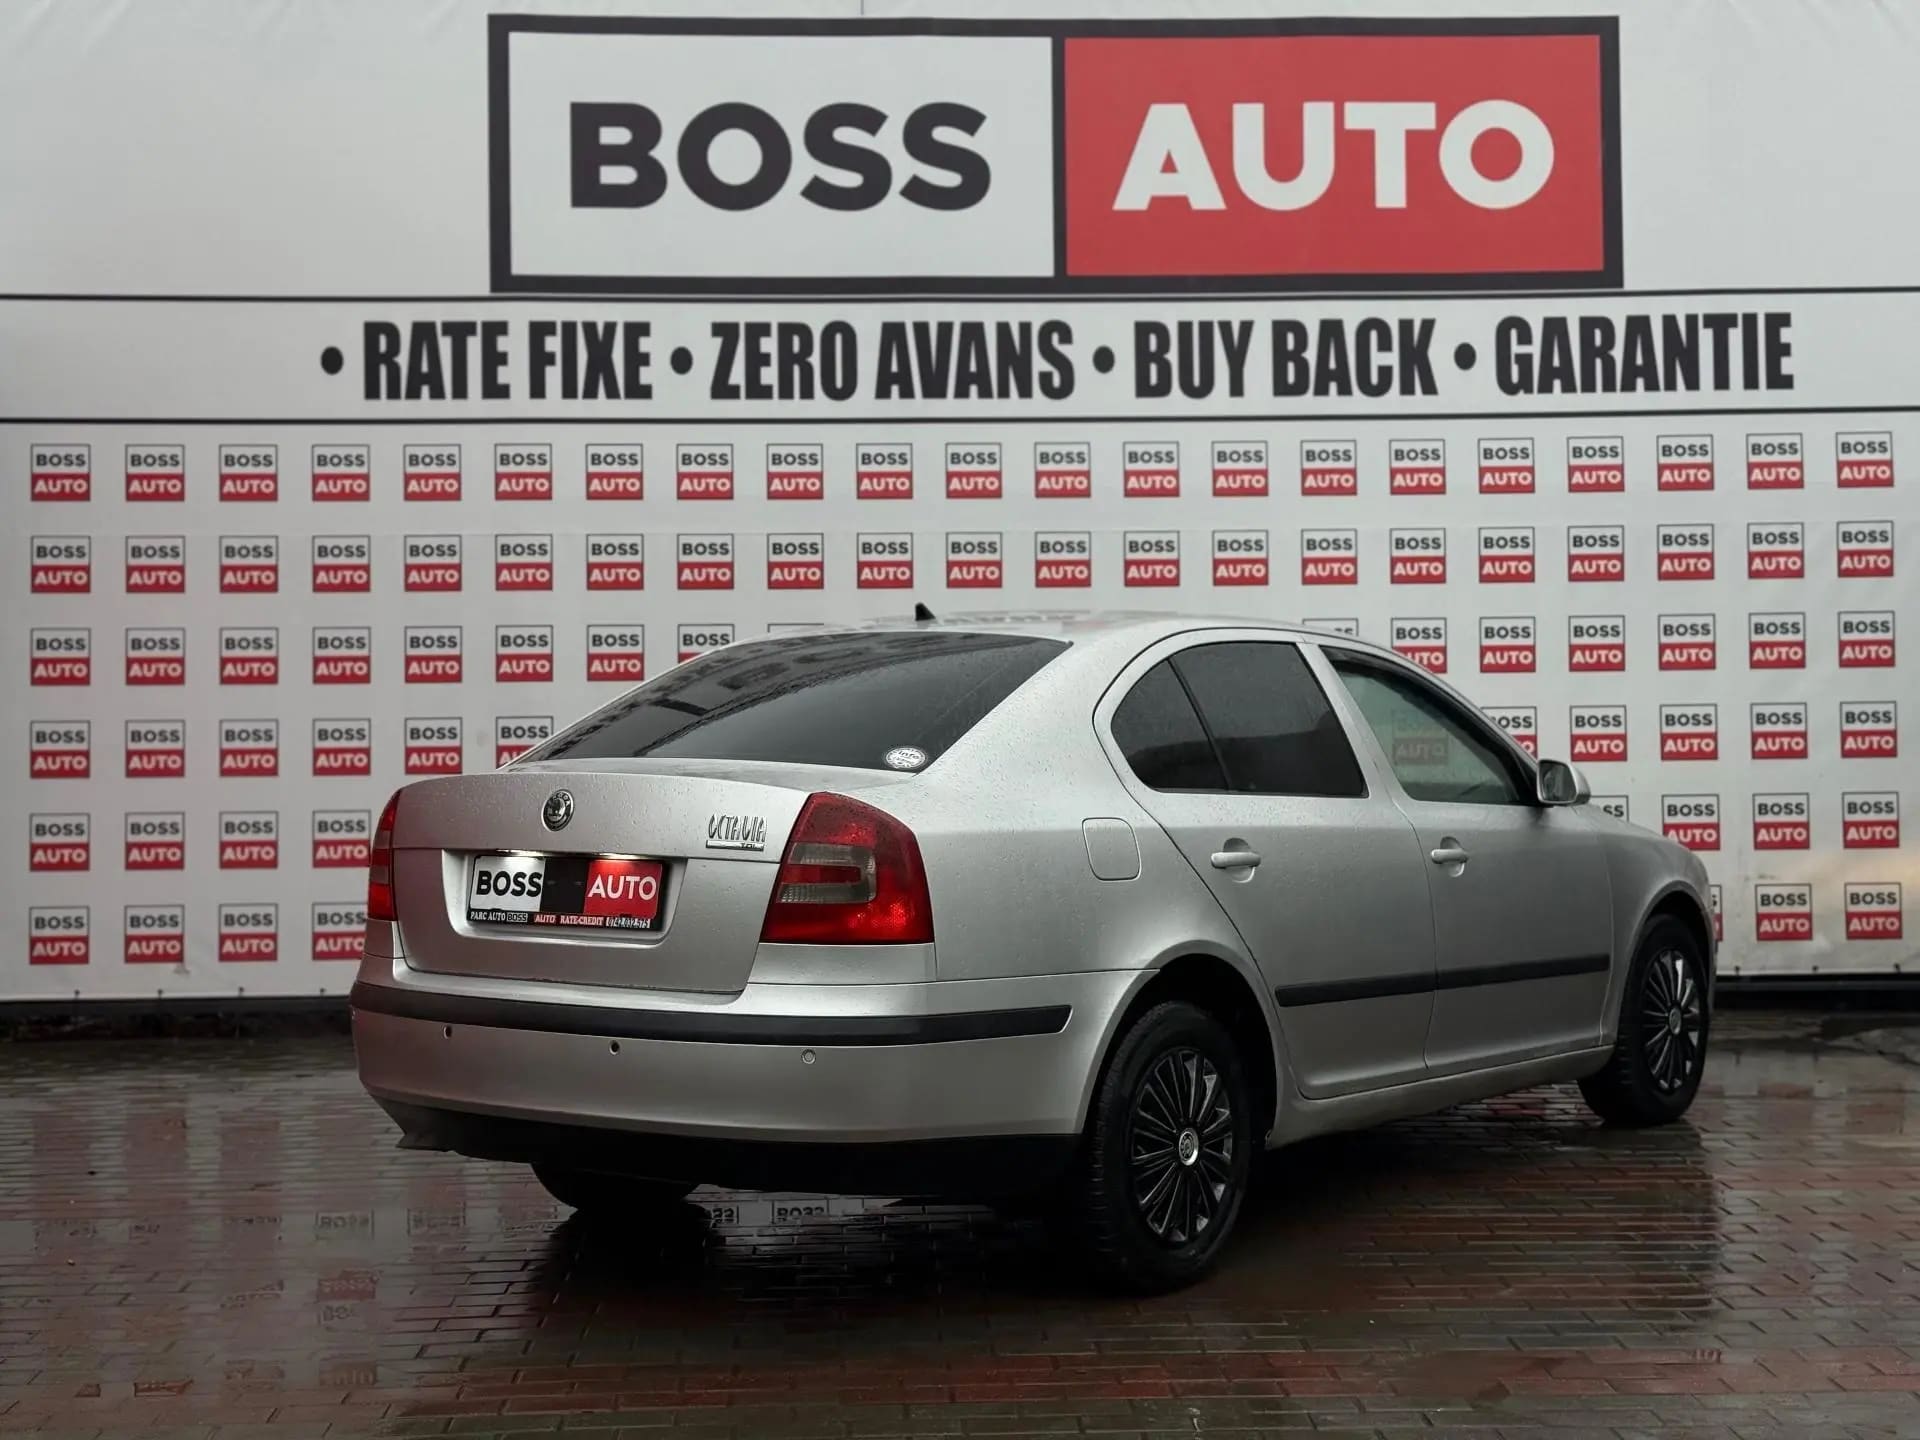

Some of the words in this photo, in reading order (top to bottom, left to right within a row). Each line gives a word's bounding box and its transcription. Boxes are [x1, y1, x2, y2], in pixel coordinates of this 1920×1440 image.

[569, 101, 992, 212] BOSS
[1111, 98, 1555, 212] AUTO
[362, 320, 509, 401] RATE
[527, 320, 653, 400] FIXE
[708, 319, 859, 402] ZERO
[874, 318, 1076, 402] AVANS
[1133, 319, 1255, 400] BUY
[1270, 317, 1439, 398] BACK
[1493, 311, 1795, 397] GARANTIE
[1482, 446, 1530, 461] BOSS
[1572, 445, 1620, 459] BOSS
[1662, 443, 1709, 458] BOSS
[1841, 440, 1889, 455] BOSS
[35, 453, 86, 467] BOSS
[130, 453, 181, 468] BOSS
[223, 453, 274, 468] BOSS
[408, 453, 457, 467] BOSS
[499, 452, 548, 467] BOSS
[590, 452, 639, 467] BOSS
[771, 452, 819, 466] BOSS
[860, 452, 909, 466] BOSS
[950, 451, 998, 465] BOSS
[1128, 450, 1175, 464] BOSS
[1216, 449, 1264, 464] BOSS
[1305, 449, 1353, 463] BOSS
[1482, 471, 1533, 486] AUTO
[1571, 470, 1622, 484] AUTO
[1661, 468, 1710, 483] AUTO
[1840, 465, 1891, 480] AUTO
[34, 478, 88, 493] AUTO
[129, 479, 182, 493] AUTO
[222, 479, 275, 494] AUTO
[407, 478, 459, 493] AUTO
[498, 478, 550, 492] AUTO
[588, 478, 641, 492] AUTO
[770, 477, 821, 492] AUTO
[859, 477, 910, 491] AUTO
[949, 476, 1000, 491] AUTO
[1127, 475, 1177, 489] AUTO
[1215, 474, 1266, 489] AUTO
[1304, 473, 1355, 488] AUTO
[1394, 536, 1442, 551] BOSS
[1483, 535, 1531, 550] BOSS
[1662, 532, 1710, 547] BOSS
[1751, 531, 1800, 546] BOSS
[1842, 529, 1890, 544] BOSS
[35, 545, 87, 559] BOSS
[224, 544, 274, 559] BOSS
[317, 544, 366, 559] BOSS
[408, 543, 458, 558] BOSS
[591, 542, 640, 556] BOSS
[681, 542, 730, 556] BOSS
[771, 542, 820, 556] BOSS
[950, 541, 998, 555] BOSS
[1039, 540, 1087, 554] BOSS
[1128, 539, 1176, 554] BOSS
[1305, 537, 1353, 552] BOSS
[1393, 561, 1444, 576] AUTO
[1481, 560, 1533, 575] AUTO
[1660, 558, 1711, 572] AUTO
[1751, 556, 1801, 571] AUTO
[1841, 554, 1891, 569] AUTO
[315, 569, 369, 584] AUTO
[407, 569, 459, 584] AUTO
[589, 567, 641, 582] AUTO
[680, 567, 731, 582] AUTO
[770, 567, 821, 581] AUTO
[949, 566, 1000, 580] AUTO
[1038, 565, 1089, 580] AUTO
[1127, 564, 1178, 579] AUTO
[1304, 562, 1355, 577] AUTO
[34, 570, 88, 585] AUTO
[223, 570, 276, 585] AUTO
[1396, 626, 1443, 640] BOSS
[1484, 625, 1532, 640] BOSS
[1573, 624, 1621, 638] BOSS
[1662, 623, 1711, 637] BOSS
[1753, 621, 1801, 636] BOSS
[1843, 620, 1891, 634] BOSS
[35, 637, 87, 652] BOSS
[130, 637, 181, 652] BOSS
[224, 636, 274, 651] BOSS
[317, 636, 367, 650] BOSS
[409, 635, 458, 649] BOSS
[500, 634, 549, 648] BOSS
[591, 633, 640, 648] BOSS
[682, 633, 730, 647] BOSS
[1482, 650, 1534, 665] AUTO
[1571, 649, 1623, 664] AUTO
[1661, 647, 1713, 663] AUTO
[1752, 646, 1802, 661] AUTO
[1842, 645, 1893, 660] AUTO
[34, 663, 88, 678] AUTO
[128, 662, 183, 677] AUTO
[222, 662, 276, 677] AUTO
[316, 661, 368, 676] AUTO
[407, 660, 460, 675] AUTO
[498, 659, 551, 674] AUTO
[590, 659, 642, 673] AUTO
[1574, 714, 1623, 729] BOSS
[1664, 713, 1713, 727] BOSS
[1755, 711, 1803, 726] BOSS
[1844, 710, 1893, 725] BOSS
[35, 730, 86, 744] BOSS
[130, 729, 181, 744] BOSS
[224, 728, 274, 743] BOSS
[317, 727, 367, 742] BOSS
[409, 726, 458, 741] BOSS
[500, 726, 549, 739] BOSS
[1573, 739, 1625, 754] AUTO
[1663, 738, 1716, 753] AUTO
[1754, 737, 1806, 752] AUTO
[1844, 735, 1895, 750] AUTO
[33, 755, 88, 771] AUTO
[128, 754, 182, 770] AUTO
[222, 754, 276, 769] AUTO
[316, 753, 368, 768] AUTO
[407, 751, 460, 767] AUTO
[1667, 803, 1716, 817] BOSS
[1757, 802, 1805, 816] BOSS
[1847, 800, 1895, 815] BOSS
[34, 823, 86, 837] BOSS
[130, 821, 180, 836] BOSS
[224, 820, 274, 835] BOSS
[317, 819, 367, 833] BOSS
[1846, 825, 1897, 841] AUTO
[1756, 827, 1807, 842] AUTO
[33, 848, 87, 863] AUTO
[129, 847, 182, 862] AUTO
[222, 846, 276, 861] AUTO
[315, 844, 368, 860] AUTO
[476, 870, 543, 898] BOSS
[586, 874, 657, 901] AUTO
[1759, 892, 1808, 907] BOSS
[1849, 891, 1898, 906] BOSS
[34, 915, 85, 930] BOSS
[129, 914, 180, 929] BOSS
[223, 913, 273, 927] BOSS
[316, 911, 367, 926] BOSS
[487, 912, 506, 921] AUTO
[507, 913, 528, 922] BOSS
[534, 914, 556, 923] AUTO
[1849, 917, 1899, 932] AUTO
[1759, 918, 1810, 933] AUTO
[32, 941, 87, 956] AUTO
[127, 940, 181, 955] AUTO
[222, 938, 275, 953] AUTO
